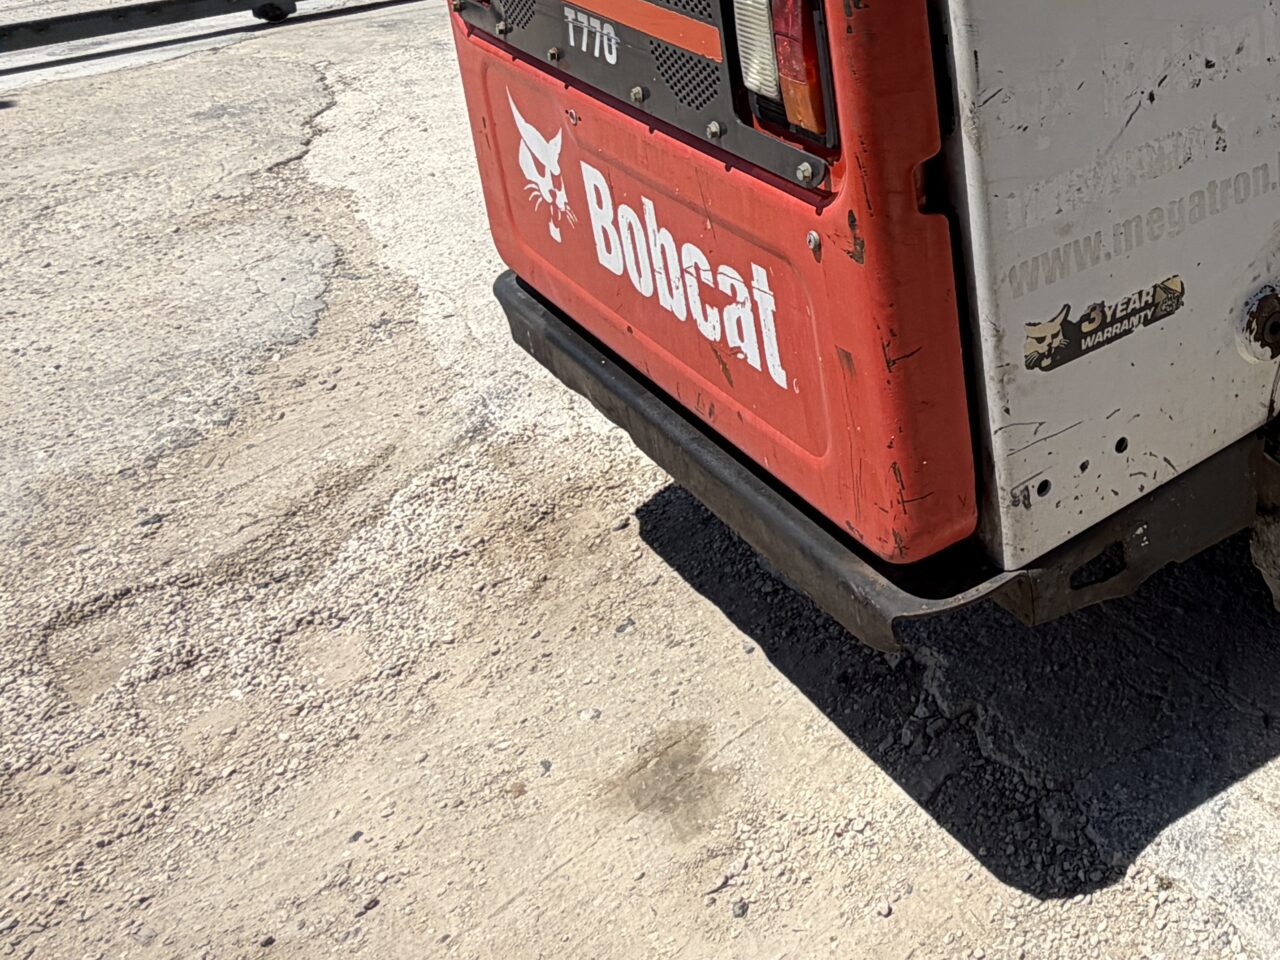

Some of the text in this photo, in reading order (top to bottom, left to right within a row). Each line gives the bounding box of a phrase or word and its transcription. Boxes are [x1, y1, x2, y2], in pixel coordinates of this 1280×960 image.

[563, 6, 618, 65] T770
[580, 160, 788, 390] Bobcat
[1081, 290, 1154, 333] 3 YEAR
[1081, 307, 1156, 351] WARRANTY
